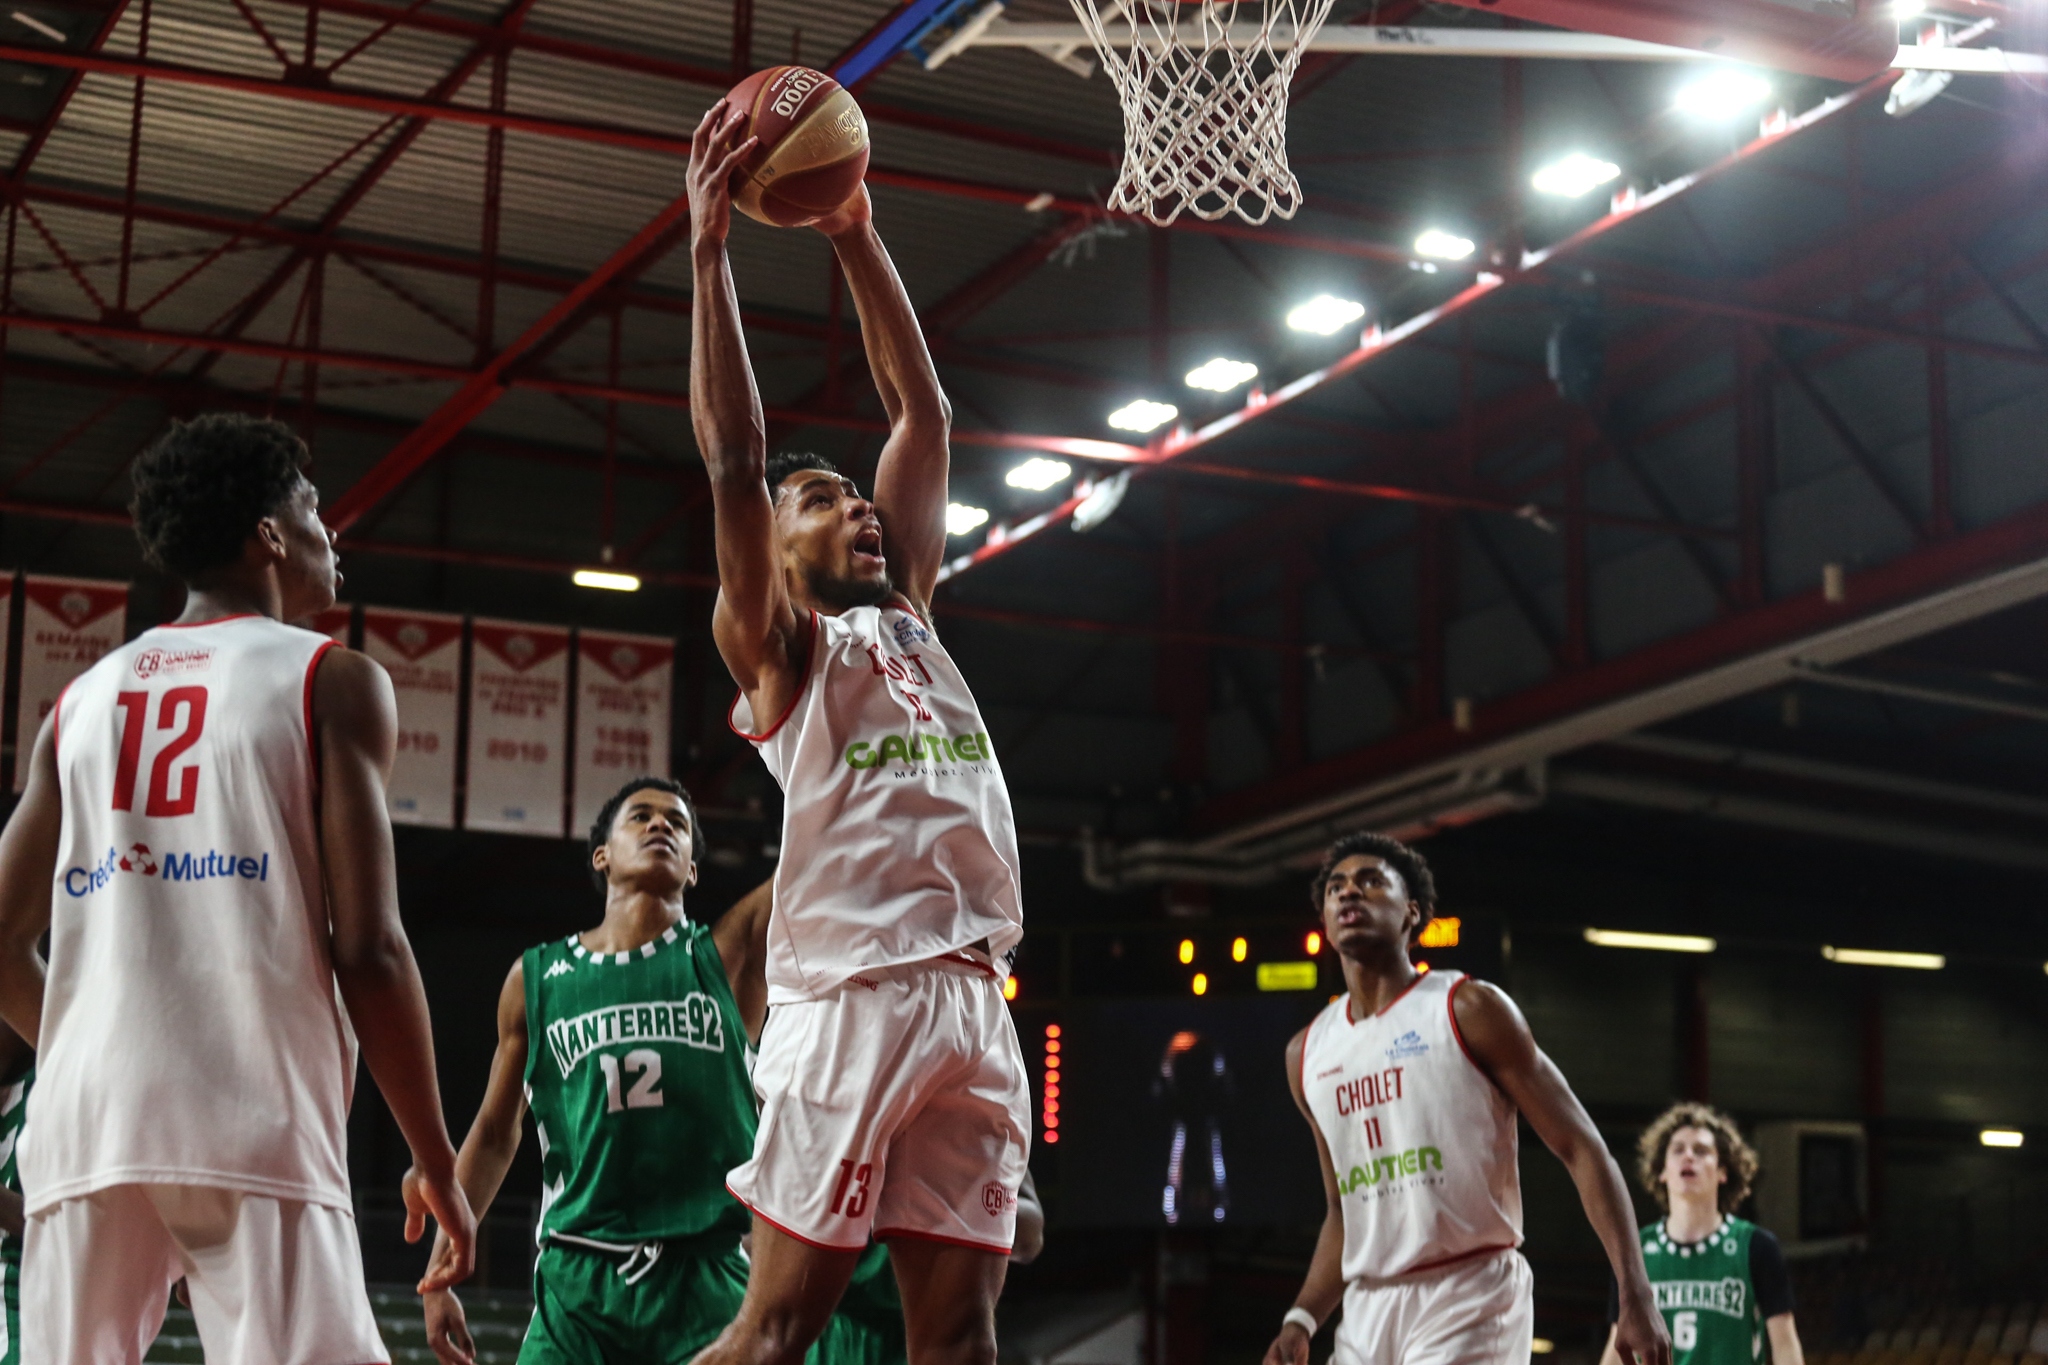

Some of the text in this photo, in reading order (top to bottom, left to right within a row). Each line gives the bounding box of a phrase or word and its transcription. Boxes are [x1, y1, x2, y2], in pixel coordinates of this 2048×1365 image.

[112, 685, 208, 818] 12
[65, 846, 269, 897] Crét Mutuel
[547, 992, 724, 1080] NANTERRE92
[600, 1049, 664, 1114] 12
[1336, 1066, 1404, 1117] CHOLET
[1364, 1116, 1383, 1150] 11
[830, 1158, 872, 1219] 13
[986, 1189, 1003, 1209] CB
[1673, 1311, 1698, 1351] 6
